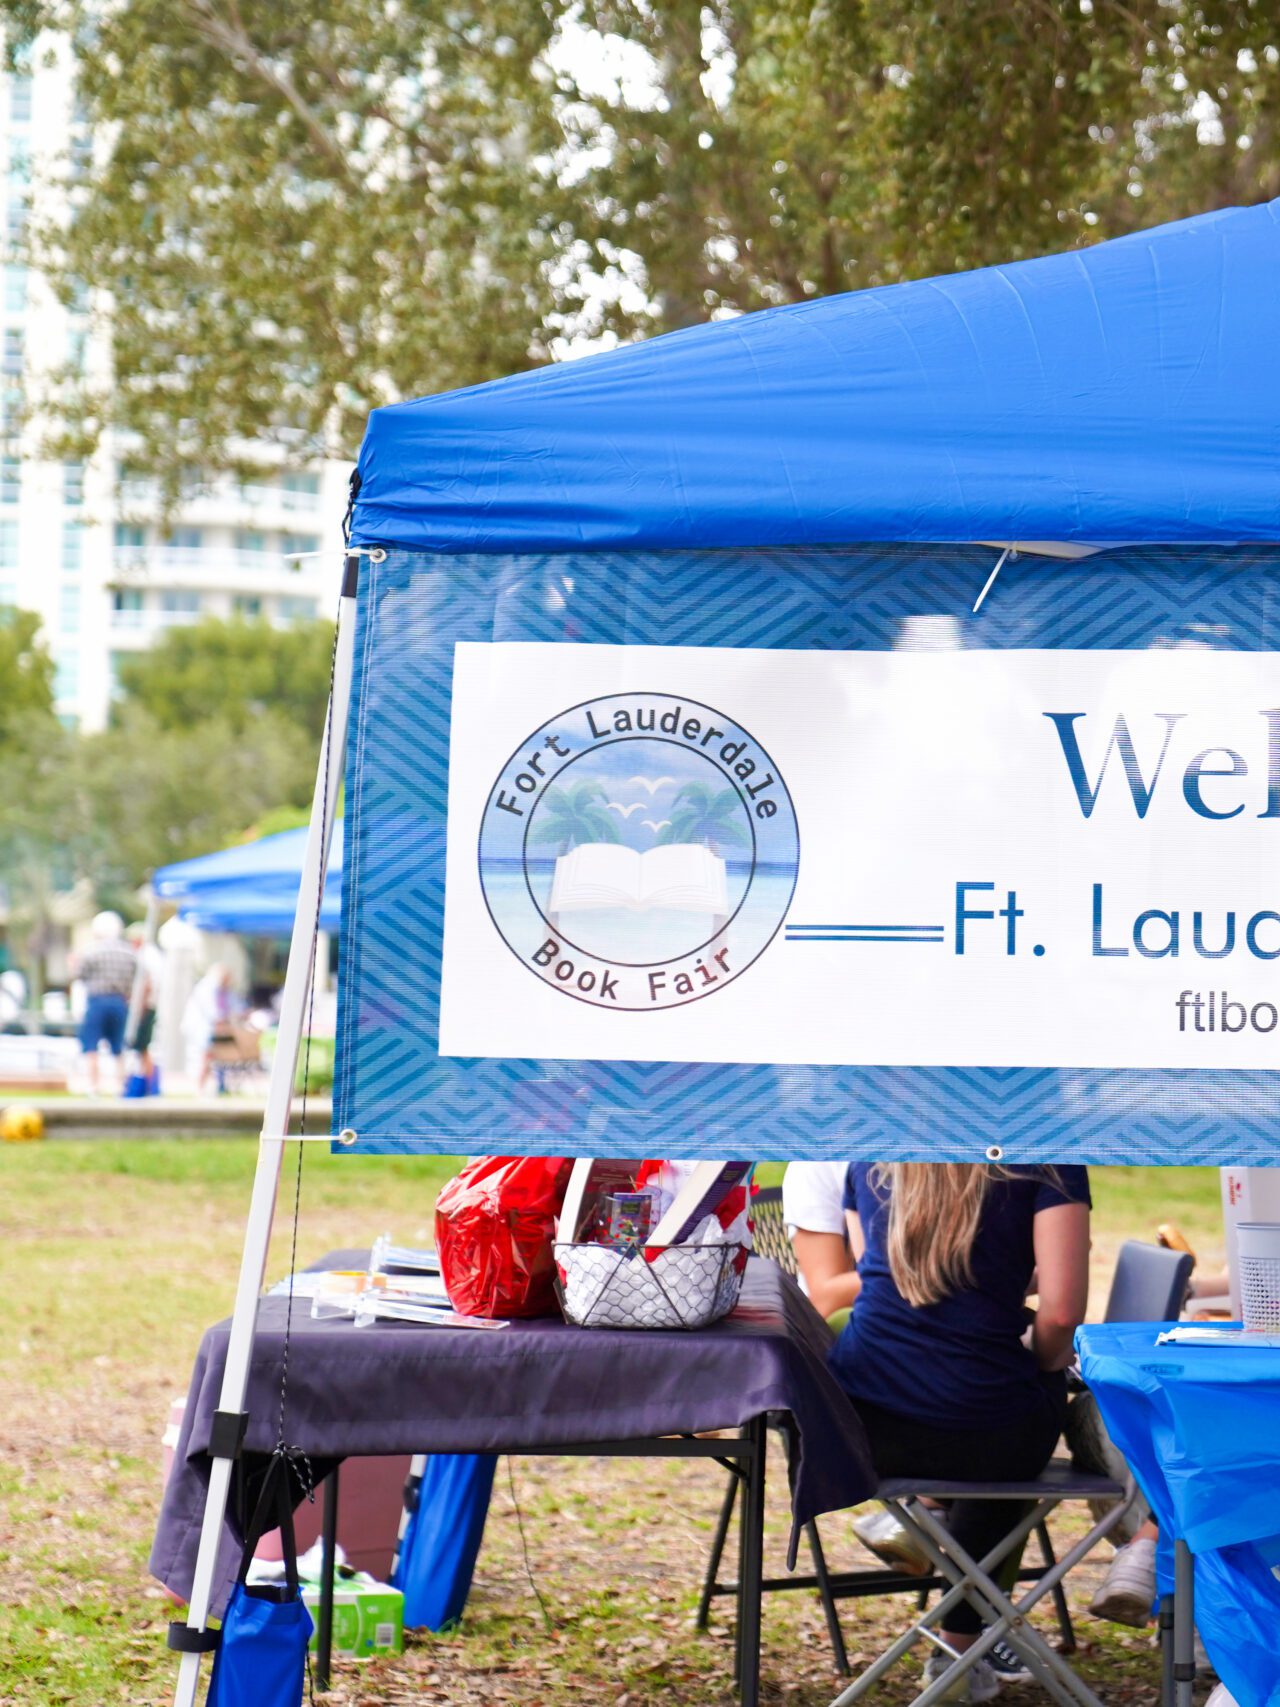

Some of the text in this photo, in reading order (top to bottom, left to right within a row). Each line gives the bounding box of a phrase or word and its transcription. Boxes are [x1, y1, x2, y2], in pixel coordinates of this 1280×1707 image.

[496, 707, 777, 819] Fort Lauderdale
[955, 880, 1047, 958] Ft.
[531, 938, 730, 1001] Book Fair
